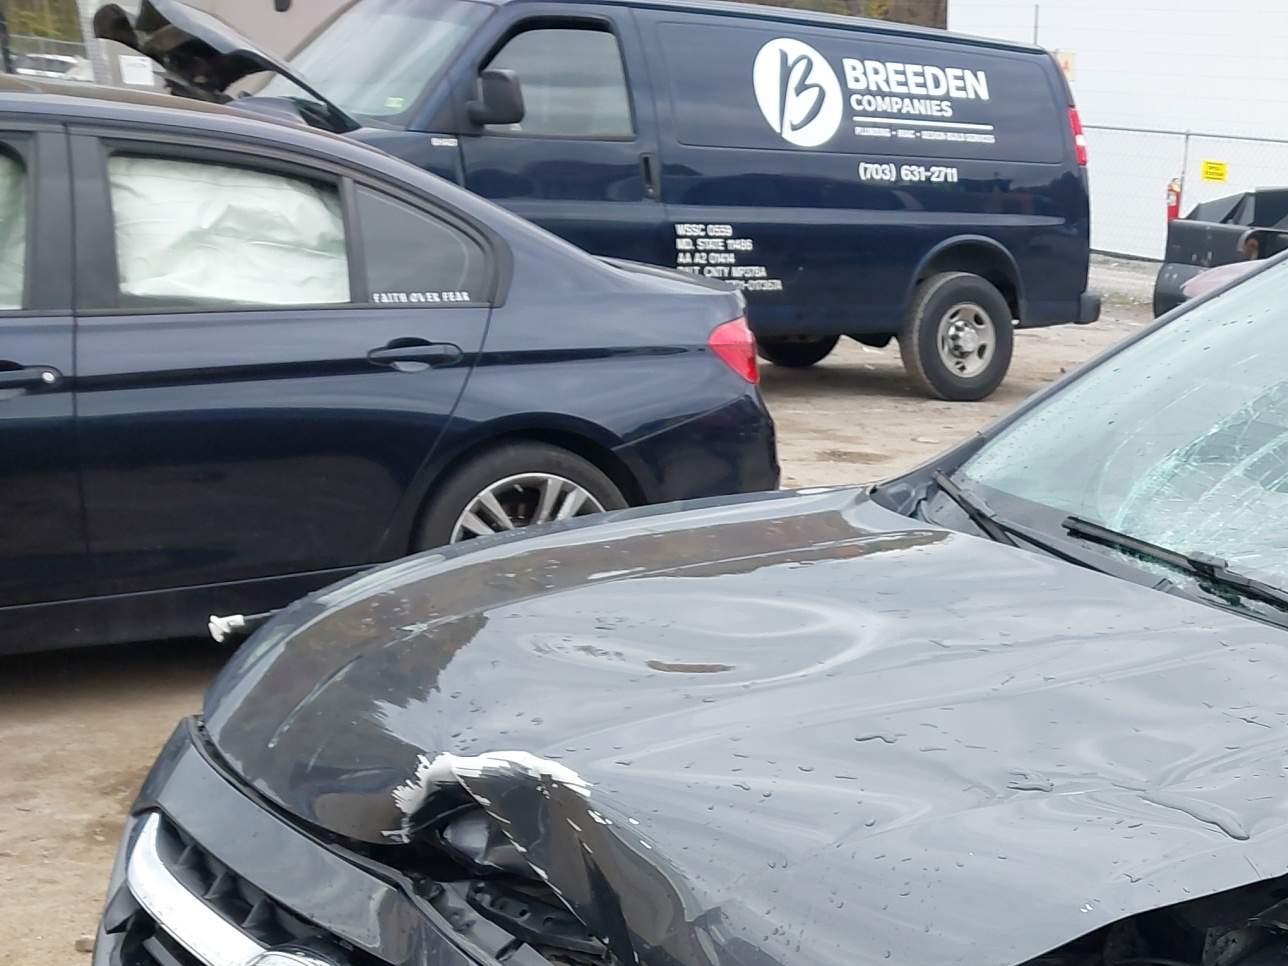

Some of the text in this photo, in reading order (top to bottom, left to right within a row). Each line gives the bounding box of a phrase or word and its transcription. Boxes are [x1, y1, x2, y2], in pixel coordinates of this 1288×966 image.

[842, 57, 990, 101] BREEDEN
[850, 94, 953, 118] COMPANIES
[858, 161, 959, 183] (703) 631-2711
[372, 292, 408, 303] FAITH
